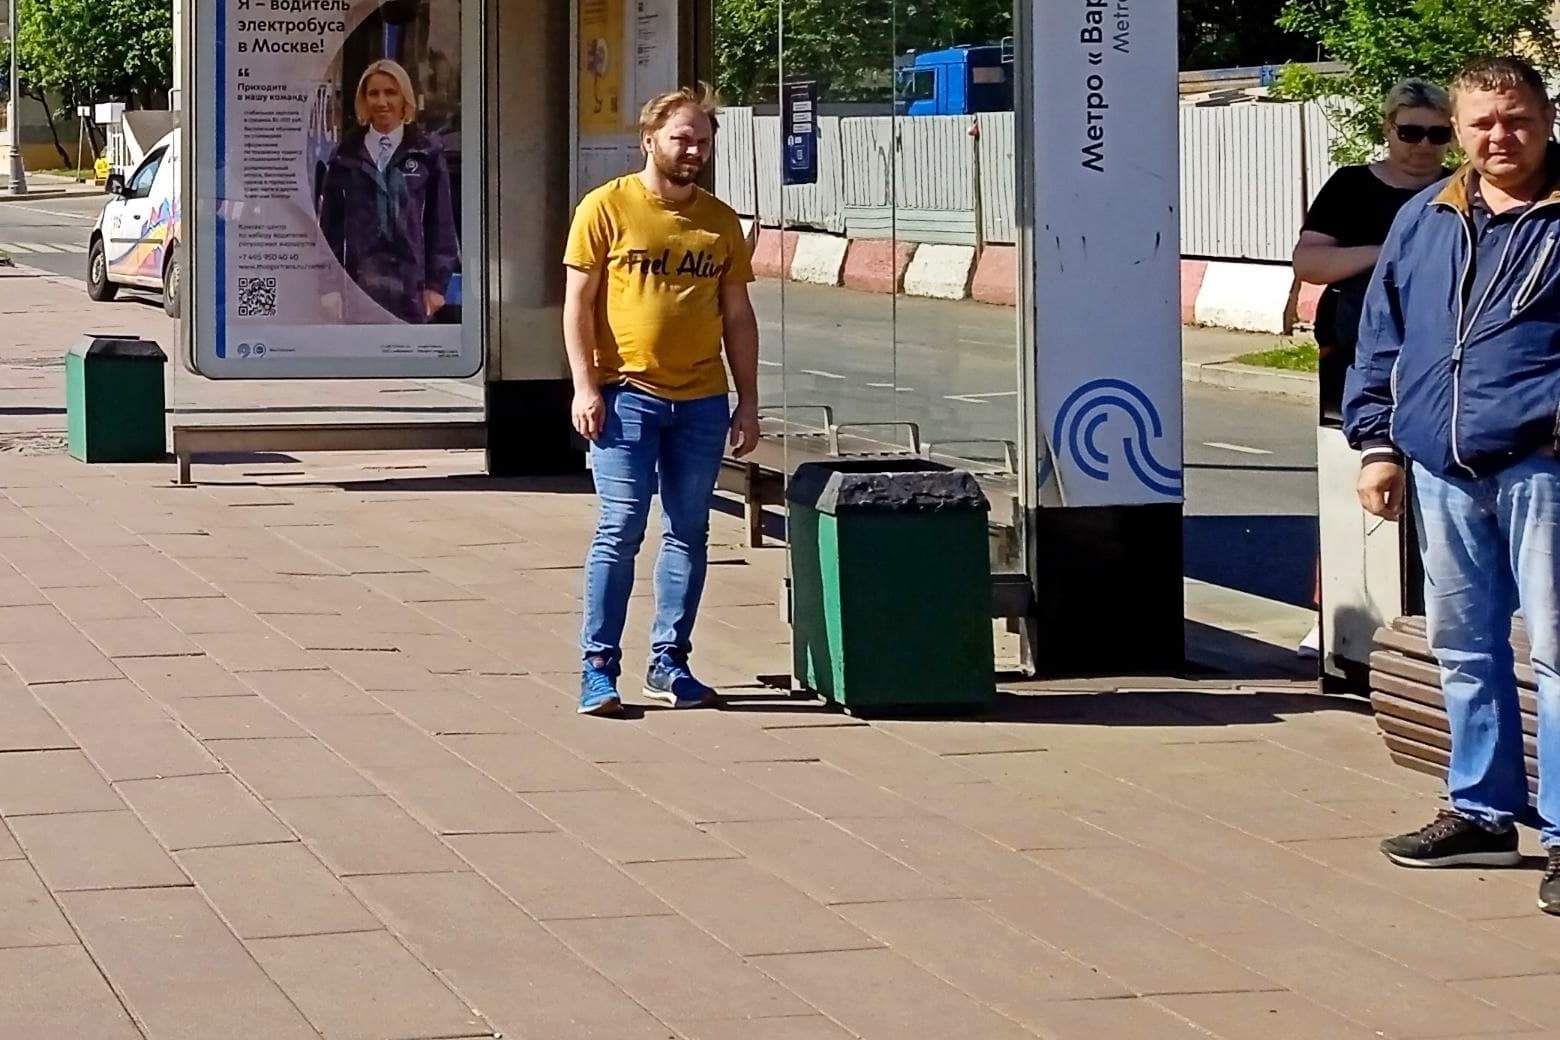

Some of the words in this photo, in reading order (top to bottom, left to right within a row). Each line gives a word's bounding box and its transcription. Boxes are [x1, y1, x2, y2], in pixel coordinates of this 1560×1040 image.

[270, 0, 351, 13] водитель
[238, 17, 345, 35] электробуса
[238, 41, 248, 53] в
[251, 38, 324, 53] Москве!
[237, 82, 287, 92] Приходите
[244, 94, 268, 102] нашу
[269, 93, 308, 102] команду
[1081, 74, 1109, 173] Метро
[626, 248, 671, 276] Feel
